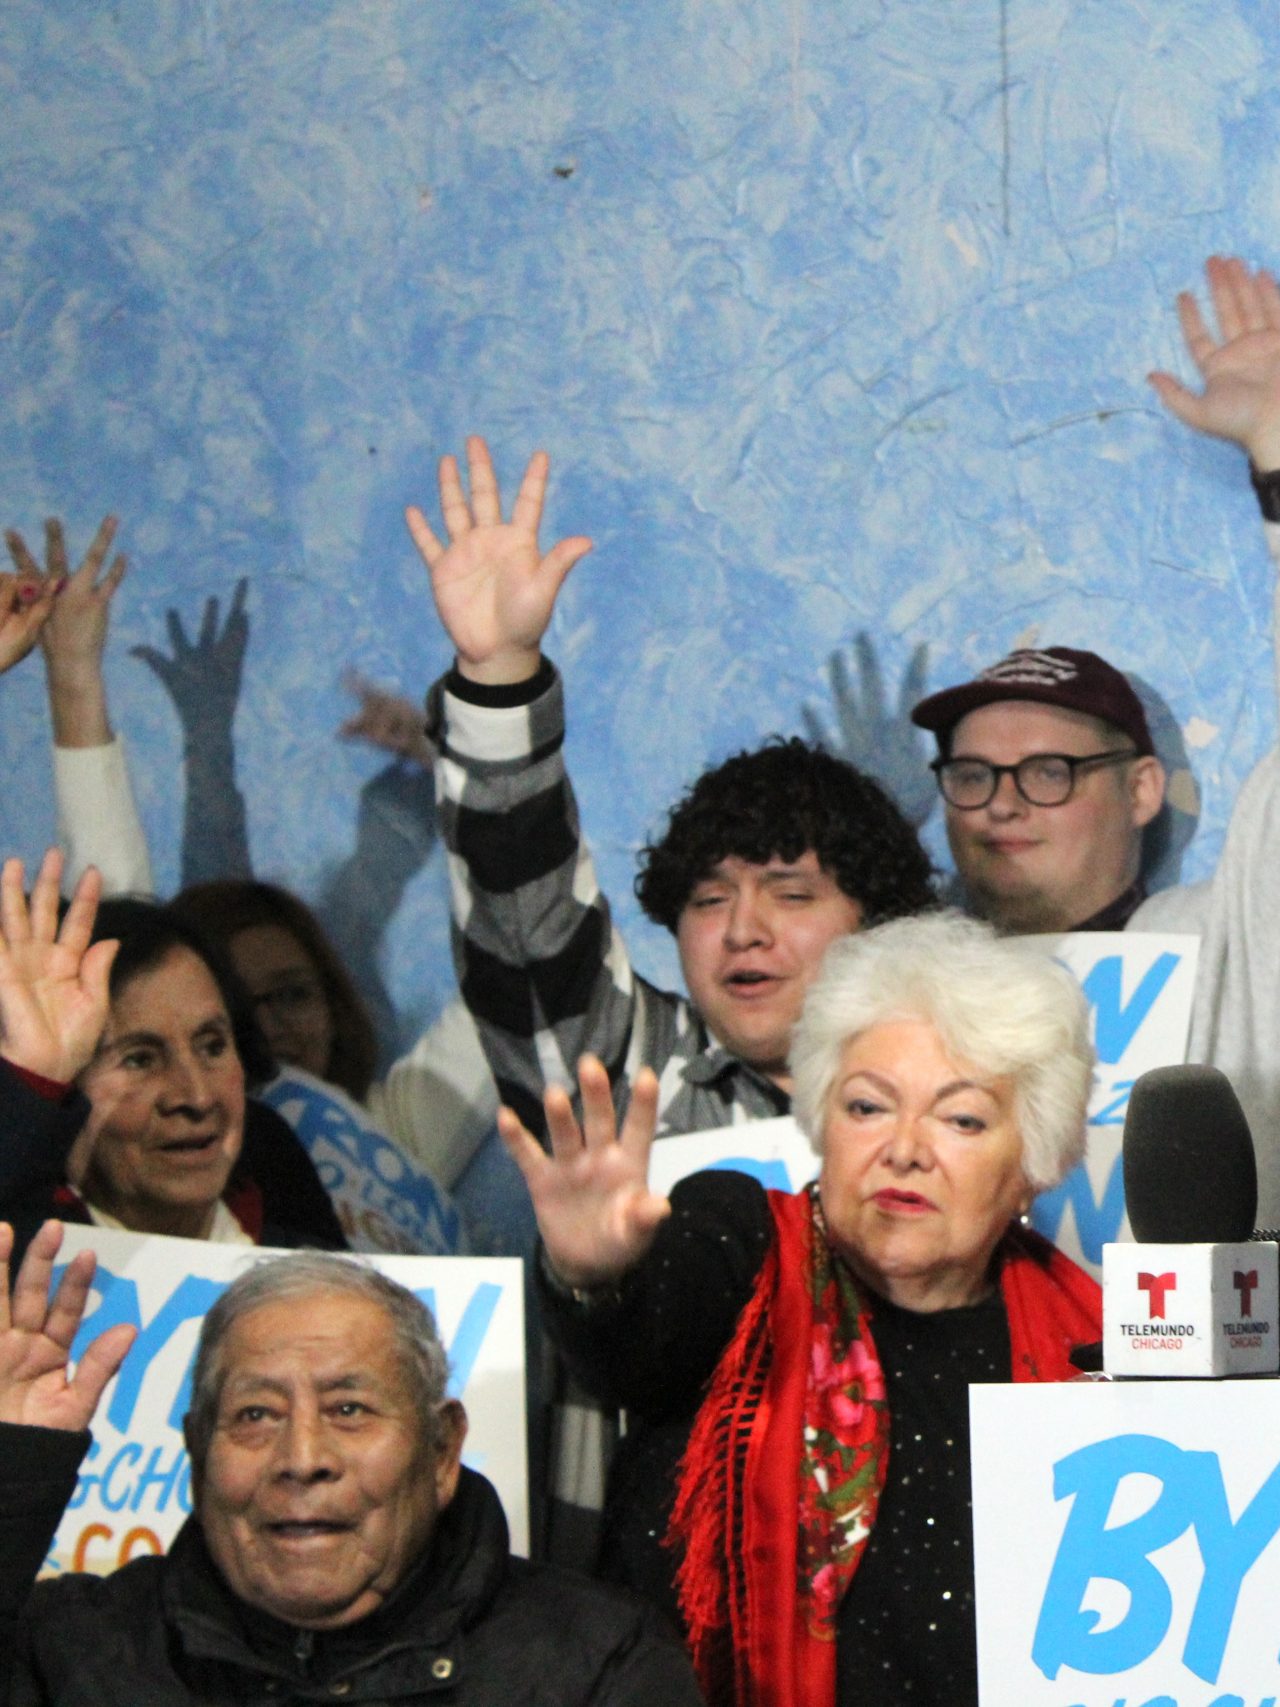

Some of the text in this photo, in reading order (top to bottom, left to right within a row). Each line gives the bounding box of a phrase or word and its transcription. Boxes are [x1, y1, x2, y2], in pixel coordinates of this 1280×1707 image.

[1121, 1324, 1195, 1336] TELEMUNDO
[1223, 1322, 1270, 1336] TELEMUNDO
[1132, 1338, 1183, 1350] CHICAGO
